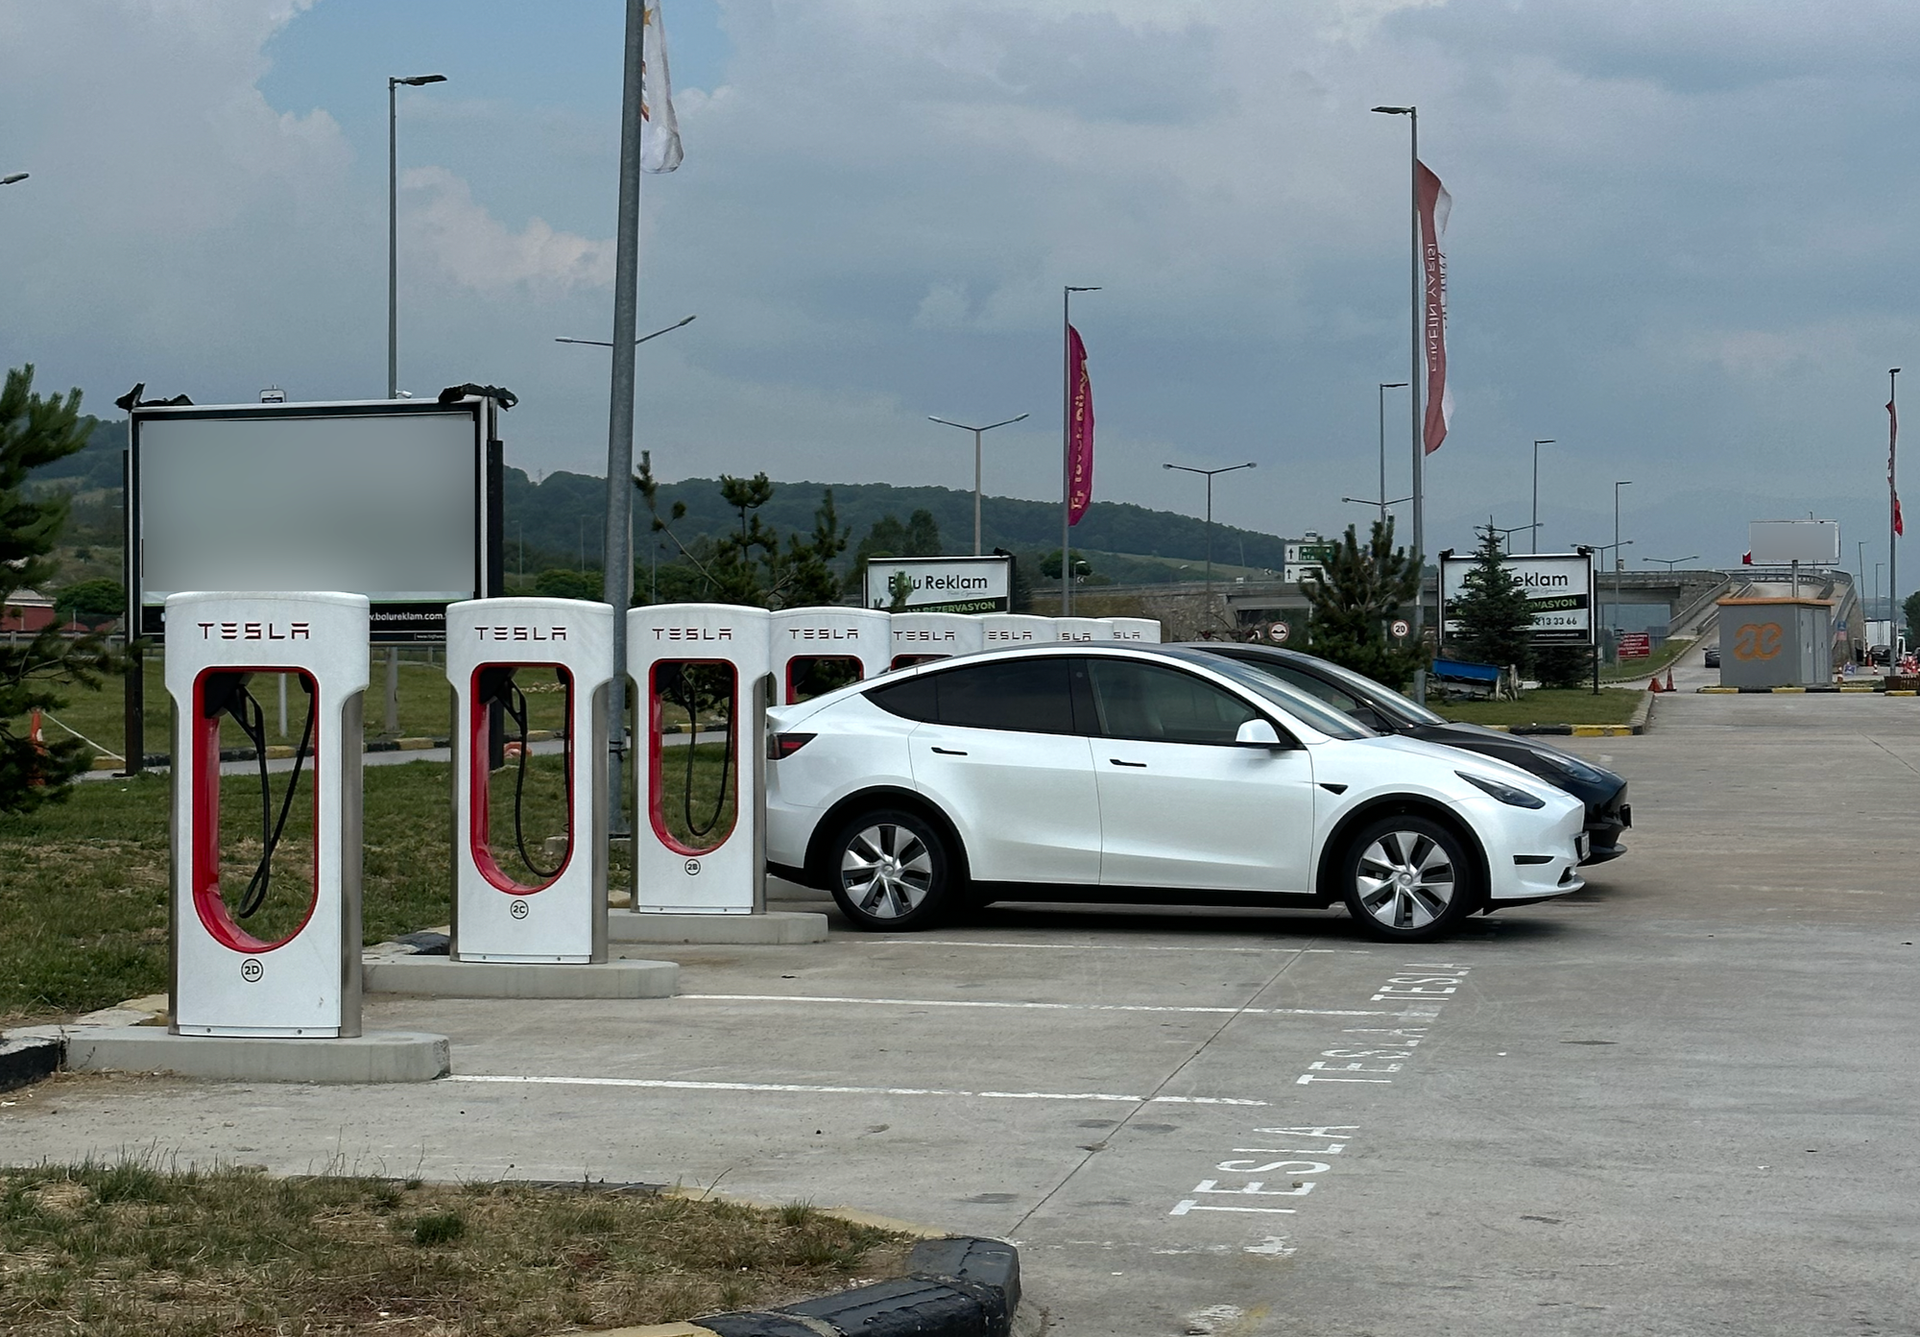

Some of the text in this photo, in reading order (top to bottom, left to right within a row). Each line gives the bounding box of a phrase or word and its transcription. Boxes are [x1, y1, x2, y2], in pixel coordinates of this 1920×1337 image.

[888, 574, 988, 590] Blu Reklam
[1509, 572, 1568, 587] eklam
[369, 612, 449, 621] w.bolureklam.com.
[1553, 617, 1564, 626] 33
[1566, 616, 1577, 626] 66
[197, 622, 310, 640] TESLA
[474, 626, 567, 641] TESLA
[652, 628, 732, 641] TESLA
[789, 629, 859, 640] TESLA
[1395, 625, 1406, 633] 20
[893, 631, 955, 641] TESLA
[987, 631, 1032, 640] ESLA
[1057, 632, 1091, 641] SLA
[1113, 631, 1141, 639] SLA
[512, 904, 526, 914] 2C
[244, 965, 260, 976] 2D
[1370, 963, 1475, 1001] TESLA
[1297, 1027, 1429, 1085] TESLA
[1169, 1125, 1361, 1215] TESLA
